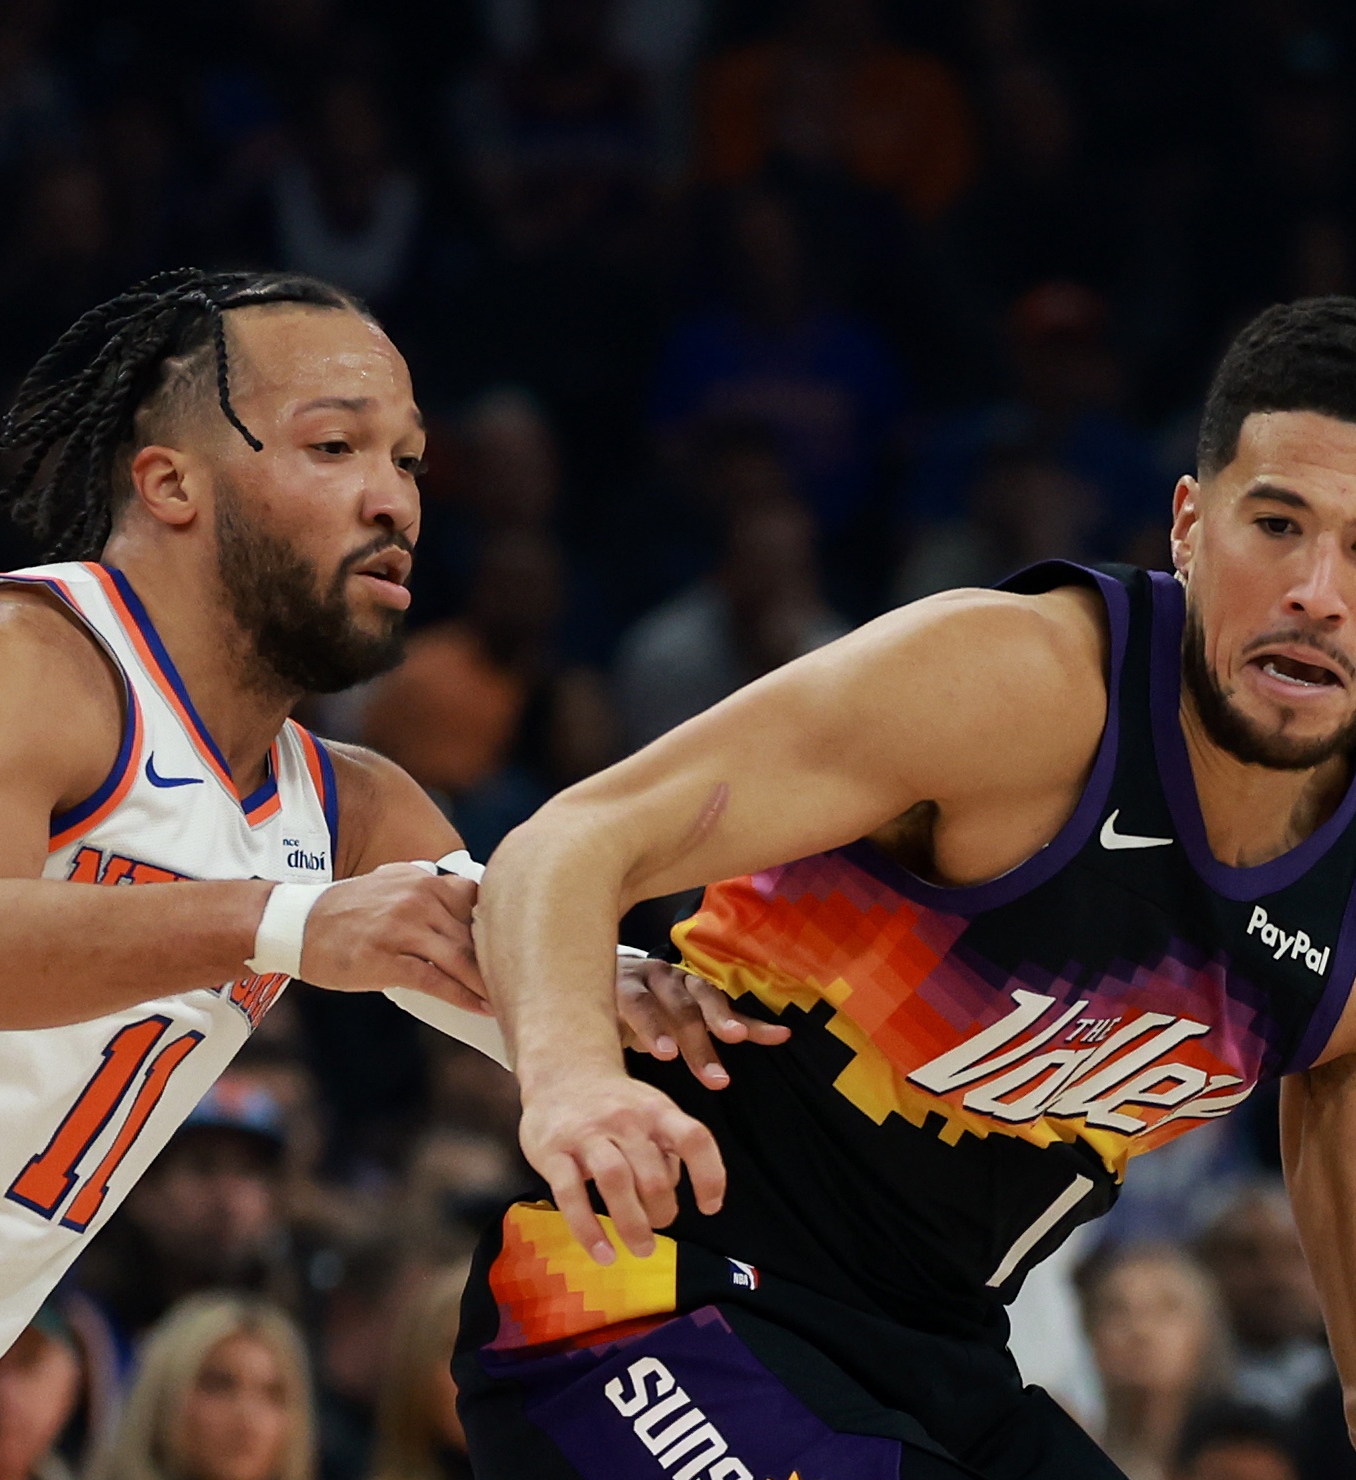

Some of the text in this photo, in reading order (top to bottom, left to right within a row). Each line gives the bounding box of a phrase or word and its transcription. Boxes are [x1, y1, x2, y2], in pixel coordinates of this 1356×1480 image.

[1246, 905, 1331, 976] PayPal
[1065, 1016, 1122, 1043] THE
[3, 1013, 207, 1235] 11
[985, 1173, 1094, 1288] 1
